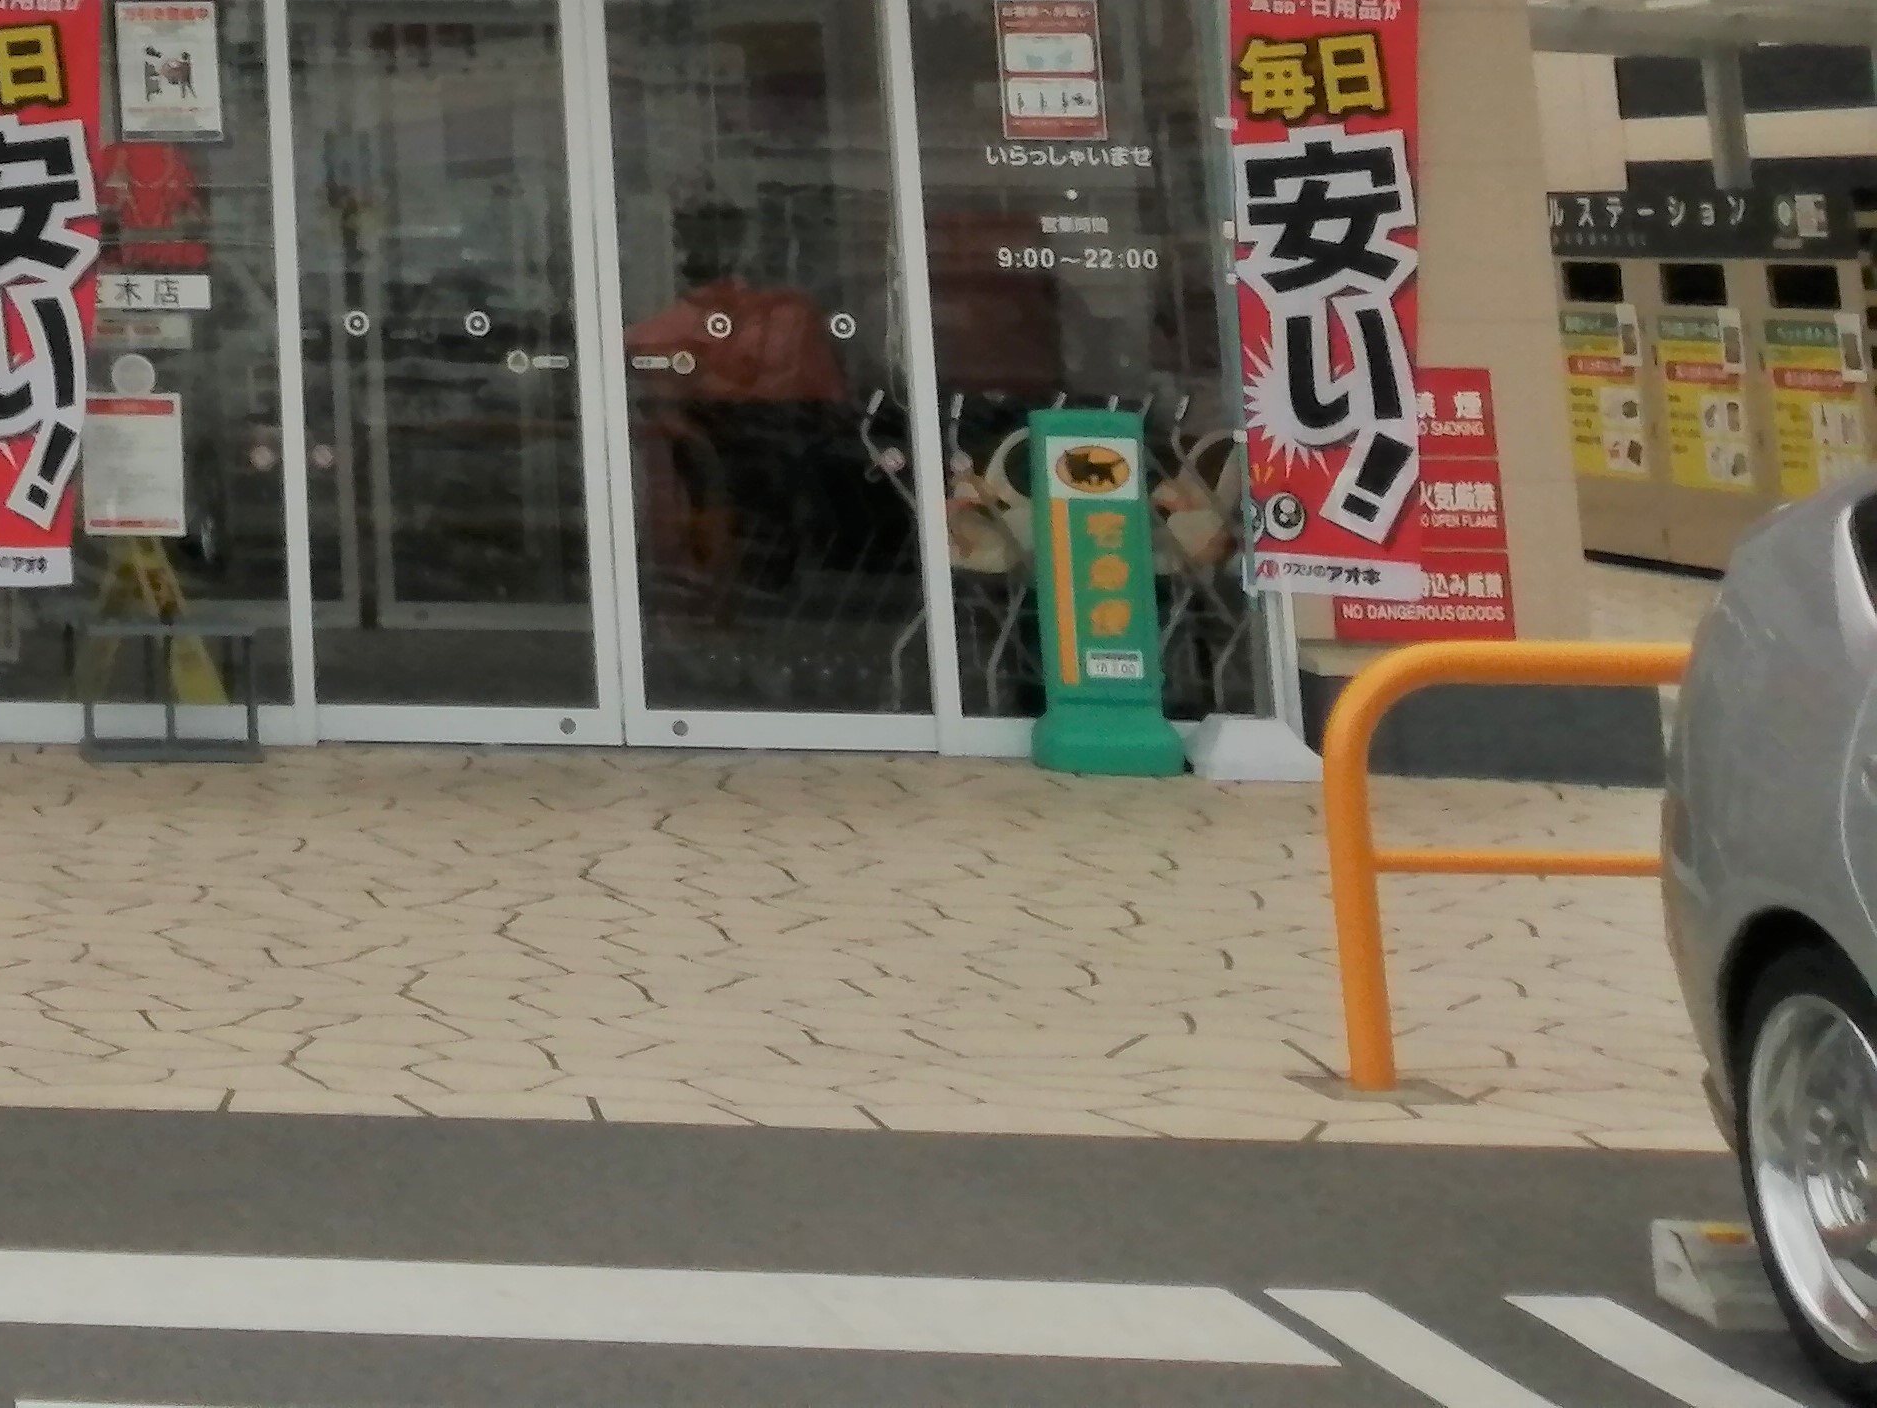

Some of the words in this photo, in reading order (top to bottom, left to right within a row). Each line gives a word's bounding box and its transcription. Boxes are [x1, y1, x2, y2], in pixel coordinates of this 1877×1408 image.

[1239, 34, 1387, 122] 毎日
[985, 145, 1153, 168] いらっしゃいませ
[1342, 603, 1363, 620] NO
[1367, 603, 1457, 621] DANGEROUS
[1457, 605, 1506, 622] GOODS
